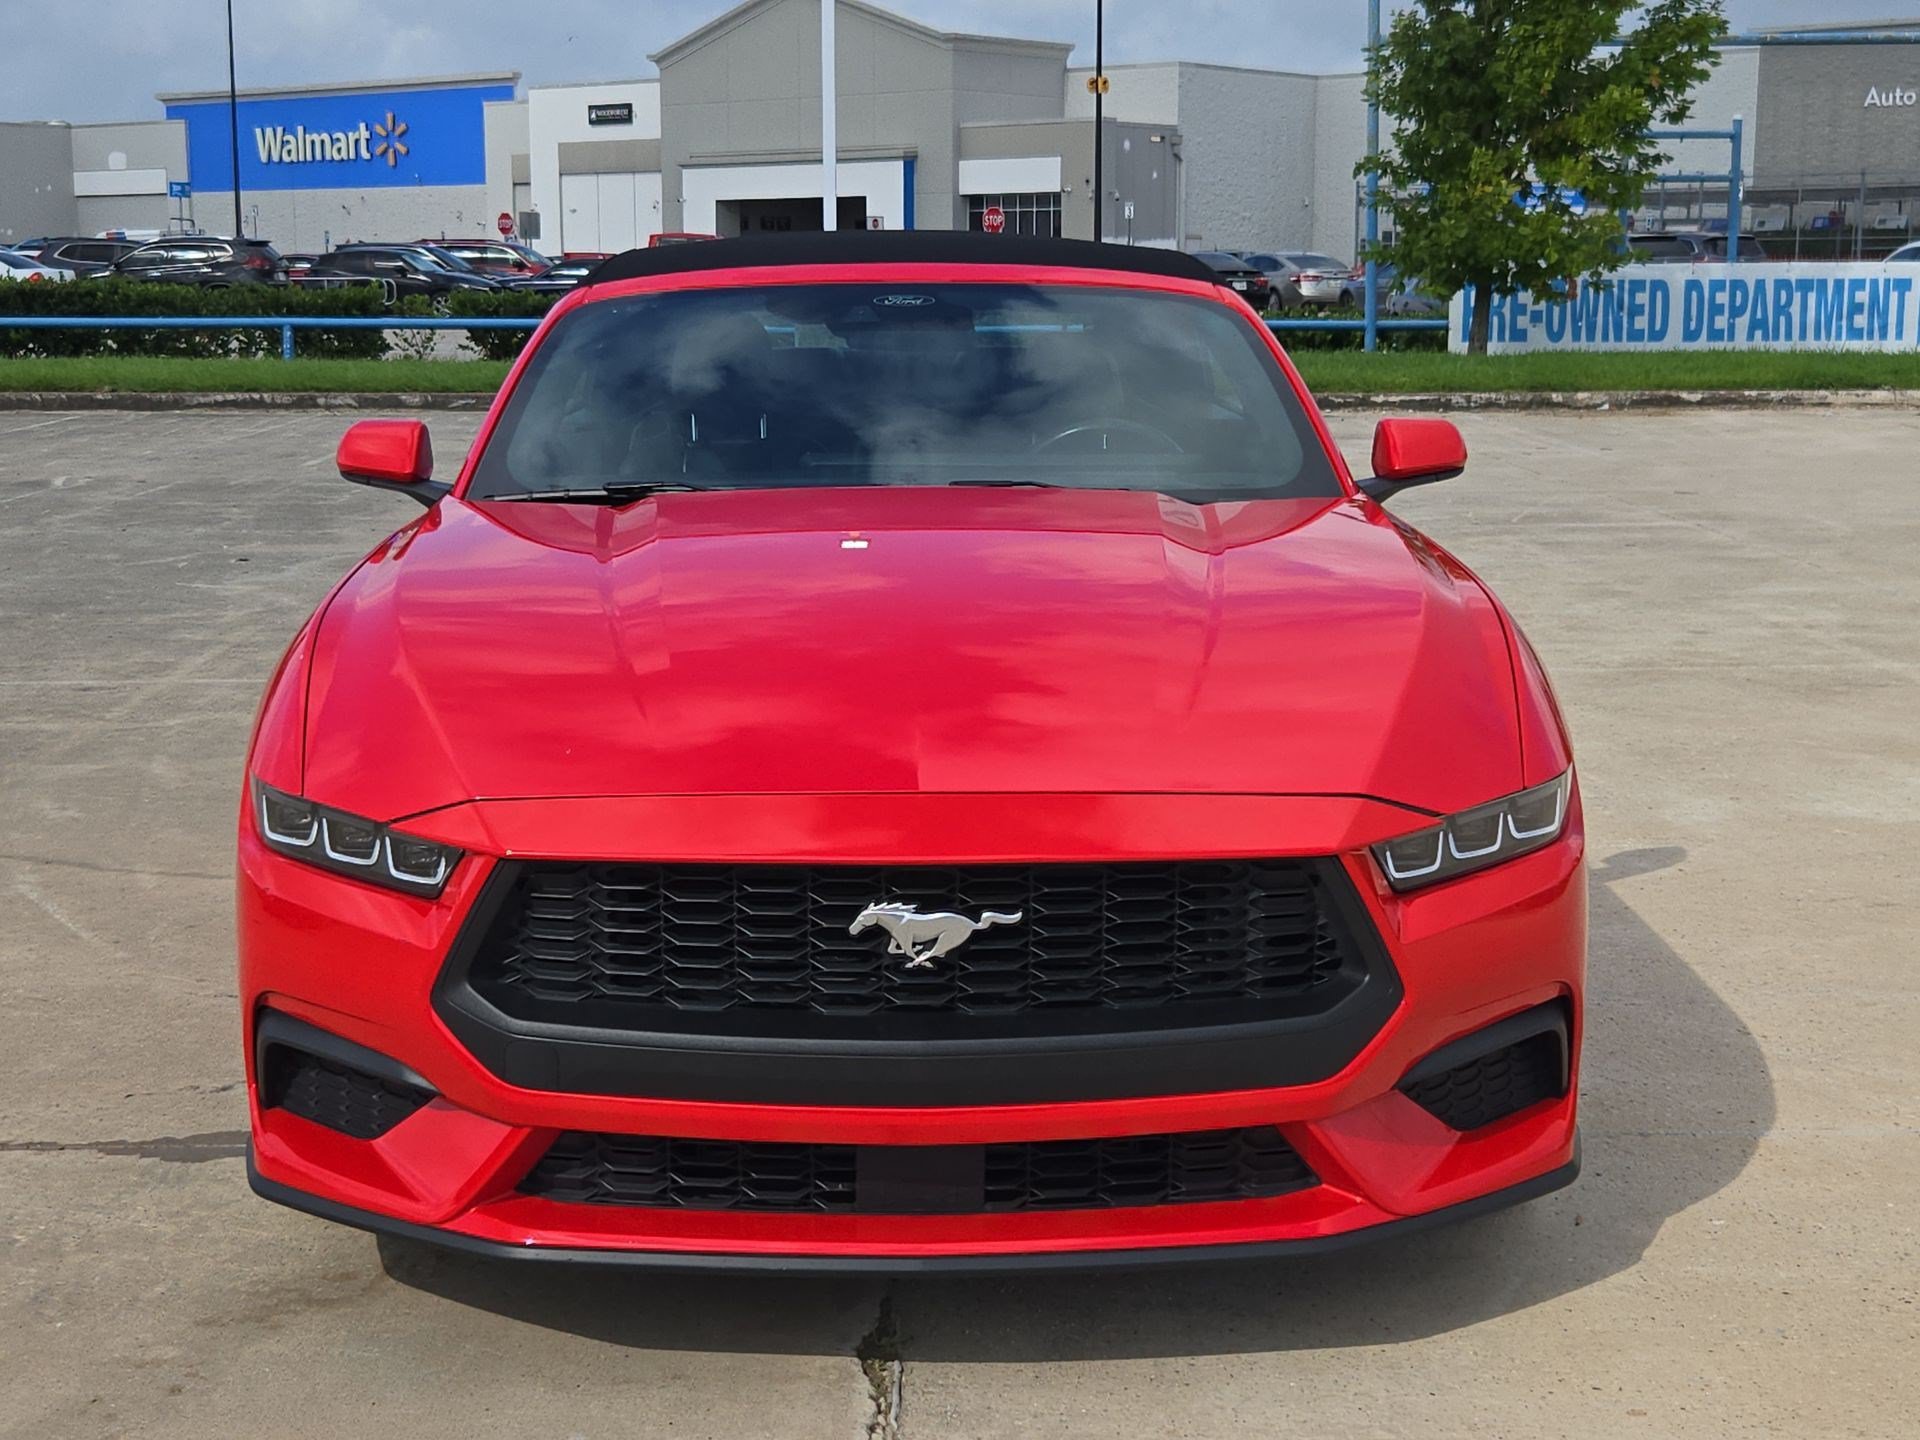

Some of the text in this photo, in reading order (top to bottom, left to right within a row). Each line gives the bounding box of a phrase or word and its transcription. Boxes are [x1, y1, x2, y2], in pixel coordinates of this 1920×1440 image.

[1863, 86, 1917, 107] Auto
[255, 122, 371, 163] Walmart
[499, 219, 513, 228] STOP
[984, 215, 1003, 226] STOP
[884, 296, 924, 305] Ford
[1681, 278, 1913, 342] DEPARTMENT
